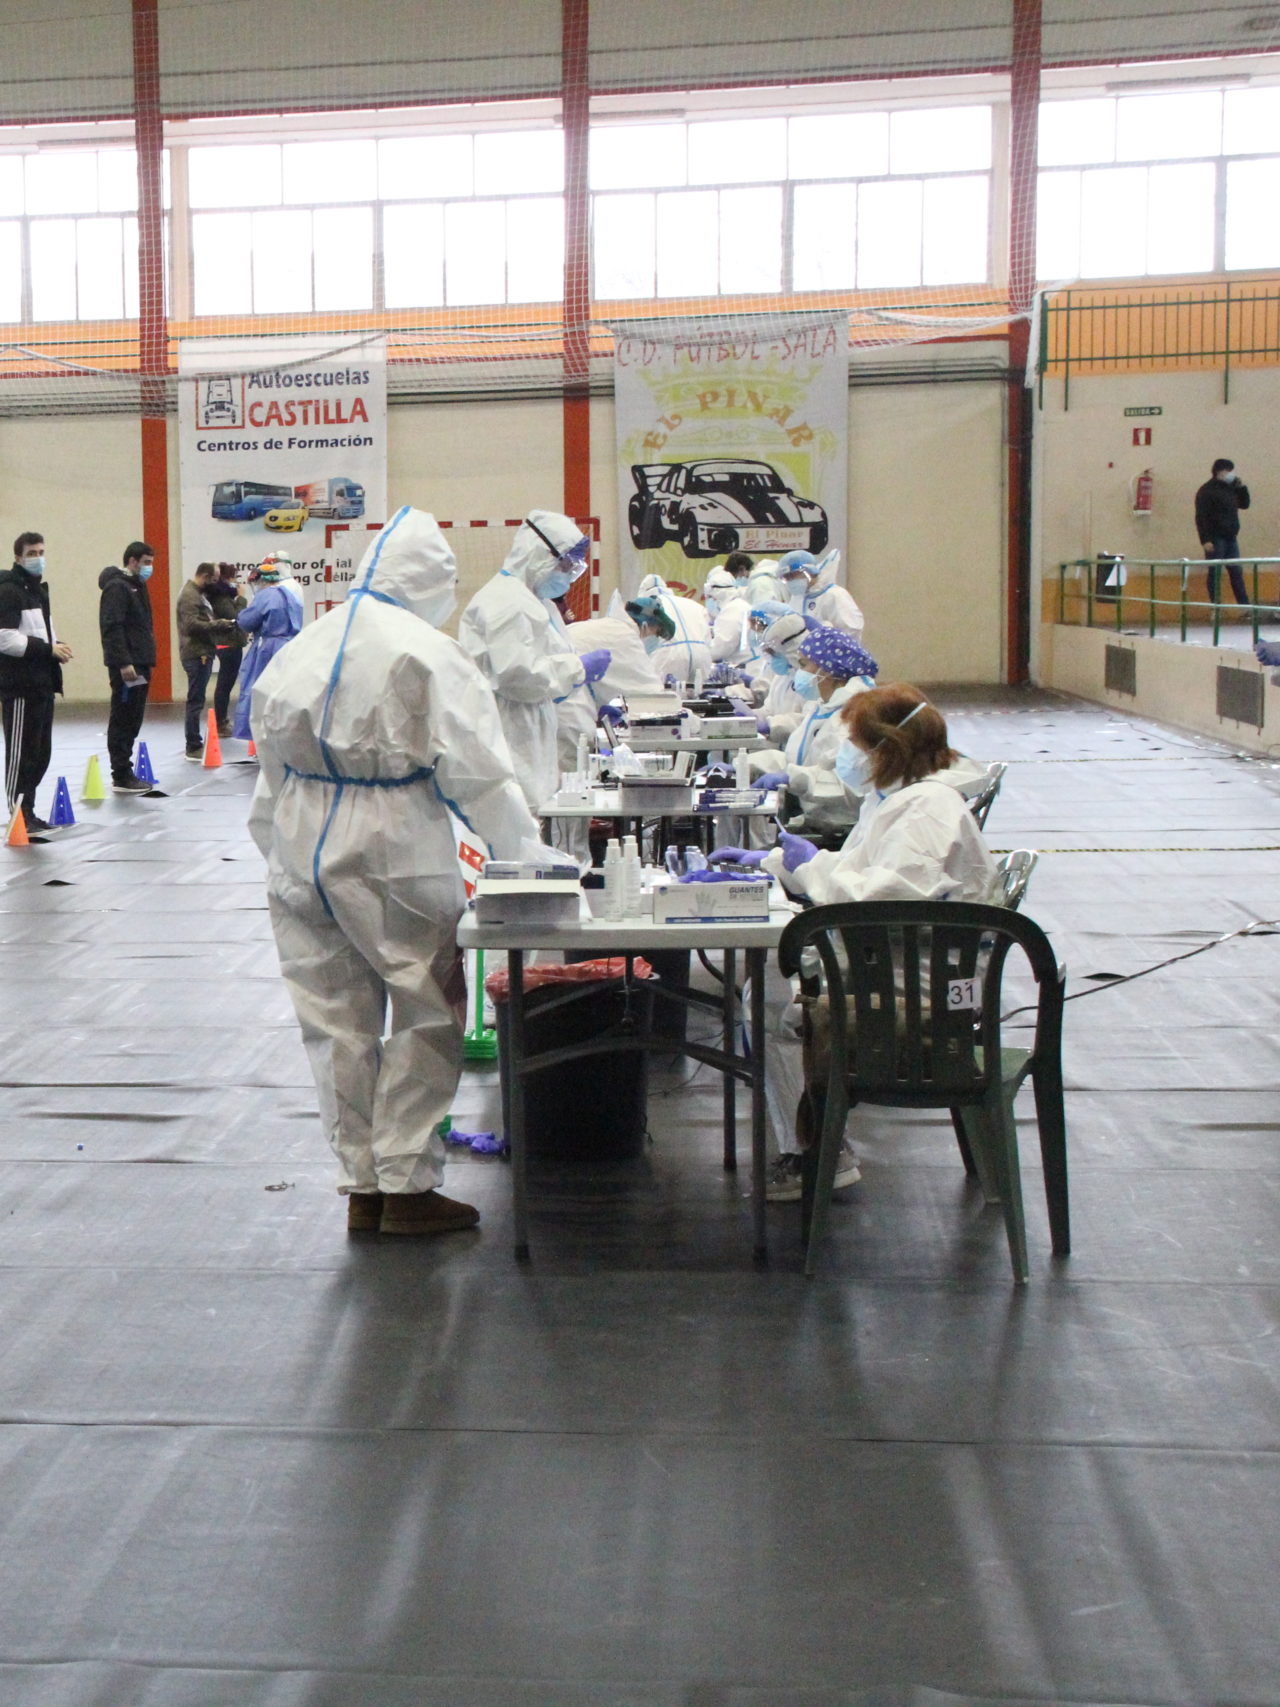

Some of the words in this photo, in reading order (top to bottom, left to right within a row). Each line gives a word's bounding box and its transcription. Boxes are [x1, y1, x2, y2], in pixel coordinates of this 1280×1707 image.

[248, 368, 370, 389] Autoescuelas
[248, 397, 369, 428] CASTILLA
[643, 413, 683, 451] EL
[696, 388, 814, 448] PINAR
[197, 439, 259, 452] Centros
[263, 438, 283, 450] de
[288, 435, 373, 449] Formación
[310, 558, 352, 570] ofial
[729, 886, 764, 894] GUANTES
[951, 984, 974, 1005] 31
